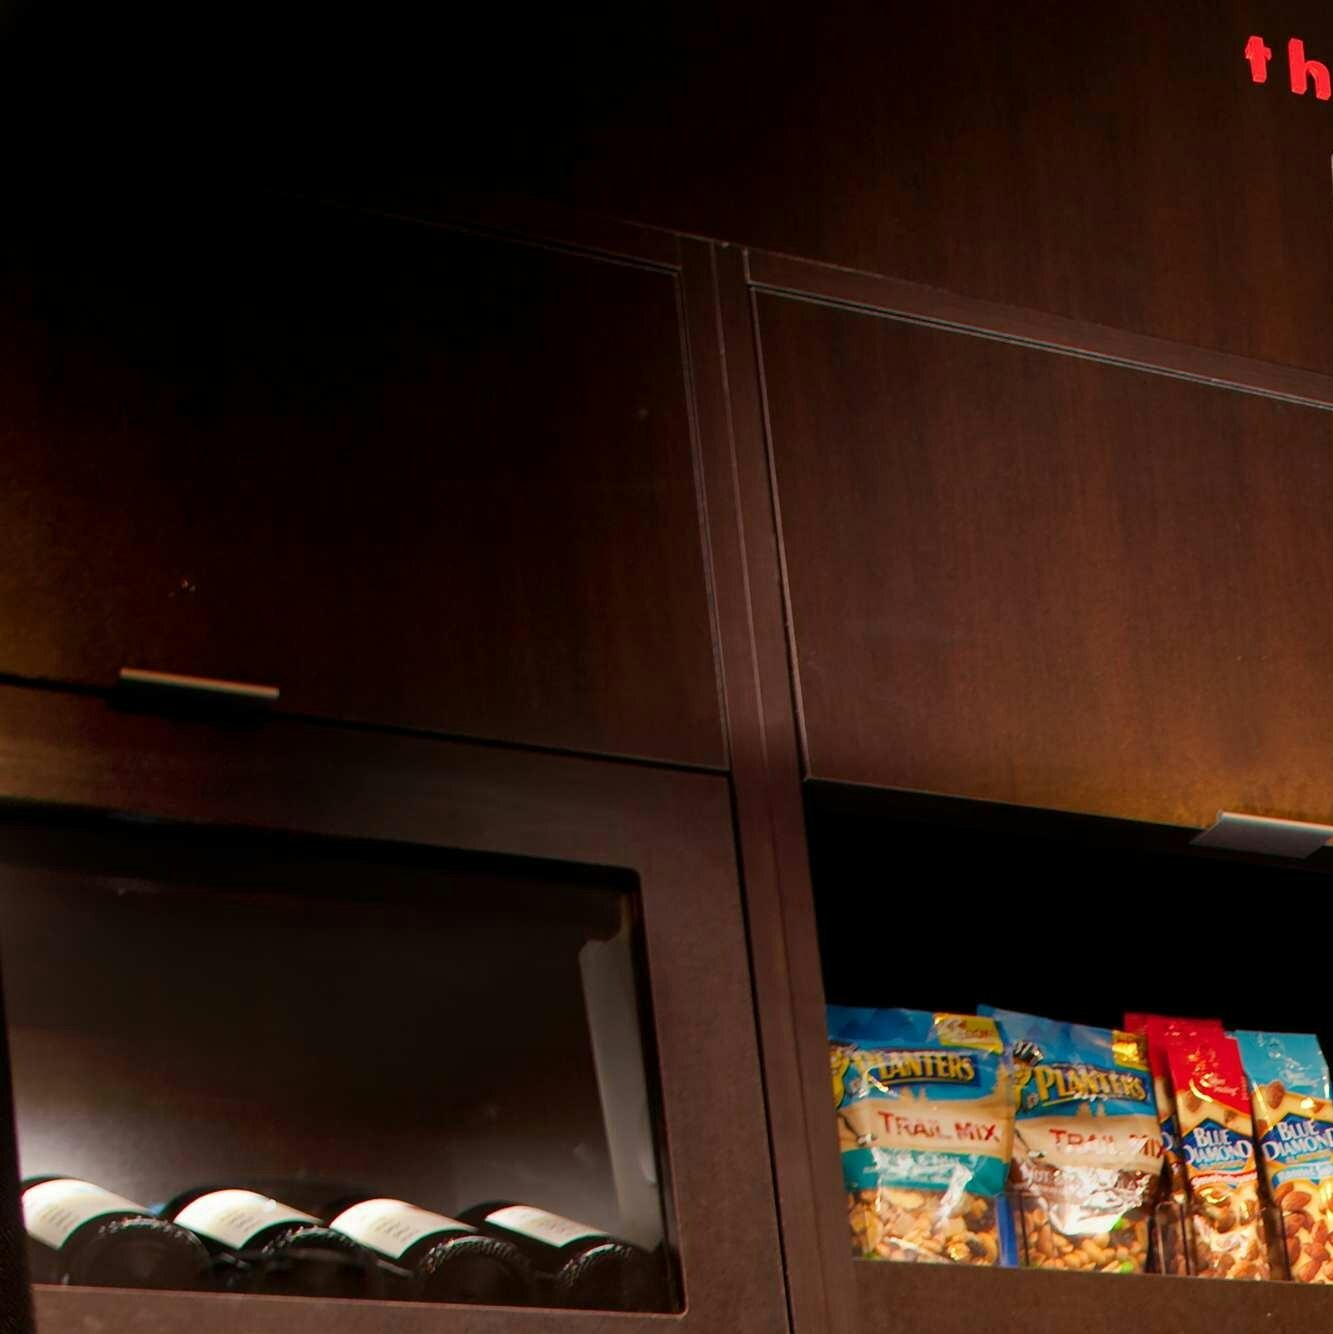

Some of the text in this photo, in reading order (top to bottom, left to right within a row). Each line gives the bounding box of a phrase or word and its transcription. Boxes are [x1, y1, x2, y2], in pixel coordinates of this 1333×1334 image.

[855, 1049, 976, 1083] PLANTERS
[1036, 1065, 1148, 1101] PLANTERS
[877, 1111, 1000, 1143] TRAIL MIX
[1048, 1127, 1166, 1159] TRAIL MIX
[1193, 1127, 1231, 1148] BLUE
[1277, 1119, 1320, 1142] BLUE
[1183, 1140, 1252, 1165] DIAMOND
